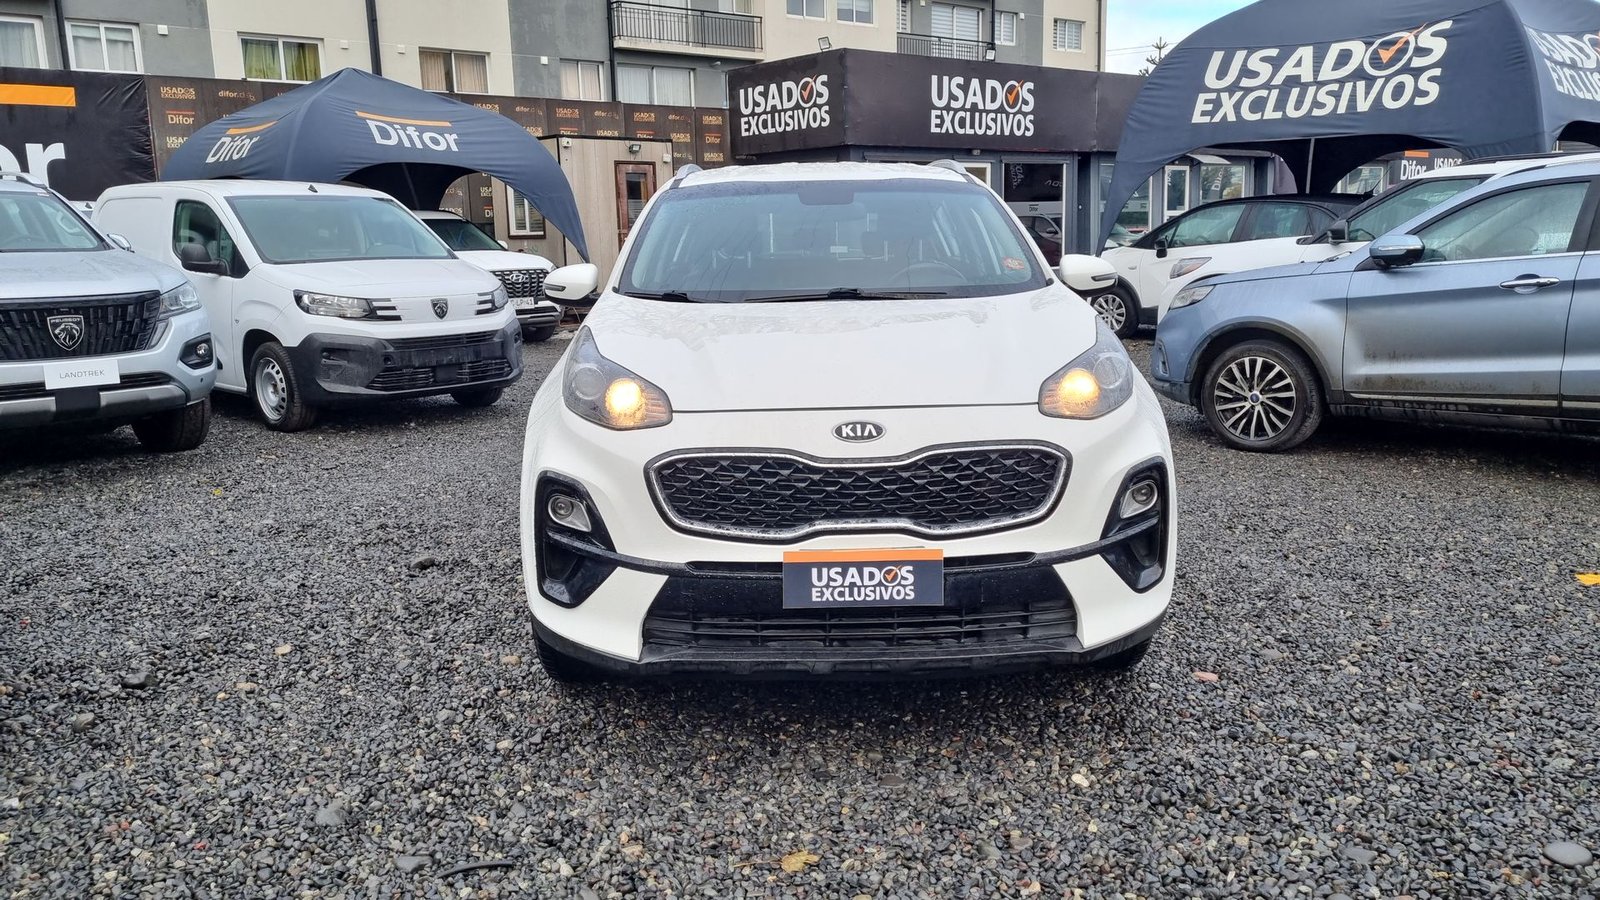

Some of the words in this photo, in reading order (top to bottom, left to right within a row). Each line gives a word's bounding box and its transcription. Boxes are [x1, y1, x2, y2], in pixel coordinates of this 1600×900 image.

[1204, 20, 1453, 89] USADOS
[160, 86, 195, 94] USADOS
[1544, 58, 1600, 101] EXCLU
[740, 75, 829, 115] USADOS
[931, 75, 1035, 113] USADOS
[1191, 68, 1442, 124] EXCLUSIVOS
[168, 115, 194, 124] Difor
[741, 105, 830, 137] EXCLUSIVOS
[930, 109, 1035, 137] EXCLUSIVOS
[205, 135, 260, 163] Difor
[365, 119, 459, 151] Difor
[59, 369, 105, 379] LANDTREK
[841, 424, 878, 437] KIA
[811, 566, 915, 587] USADOS
[811, 585, 915, 602] EXCLUSIVOS
